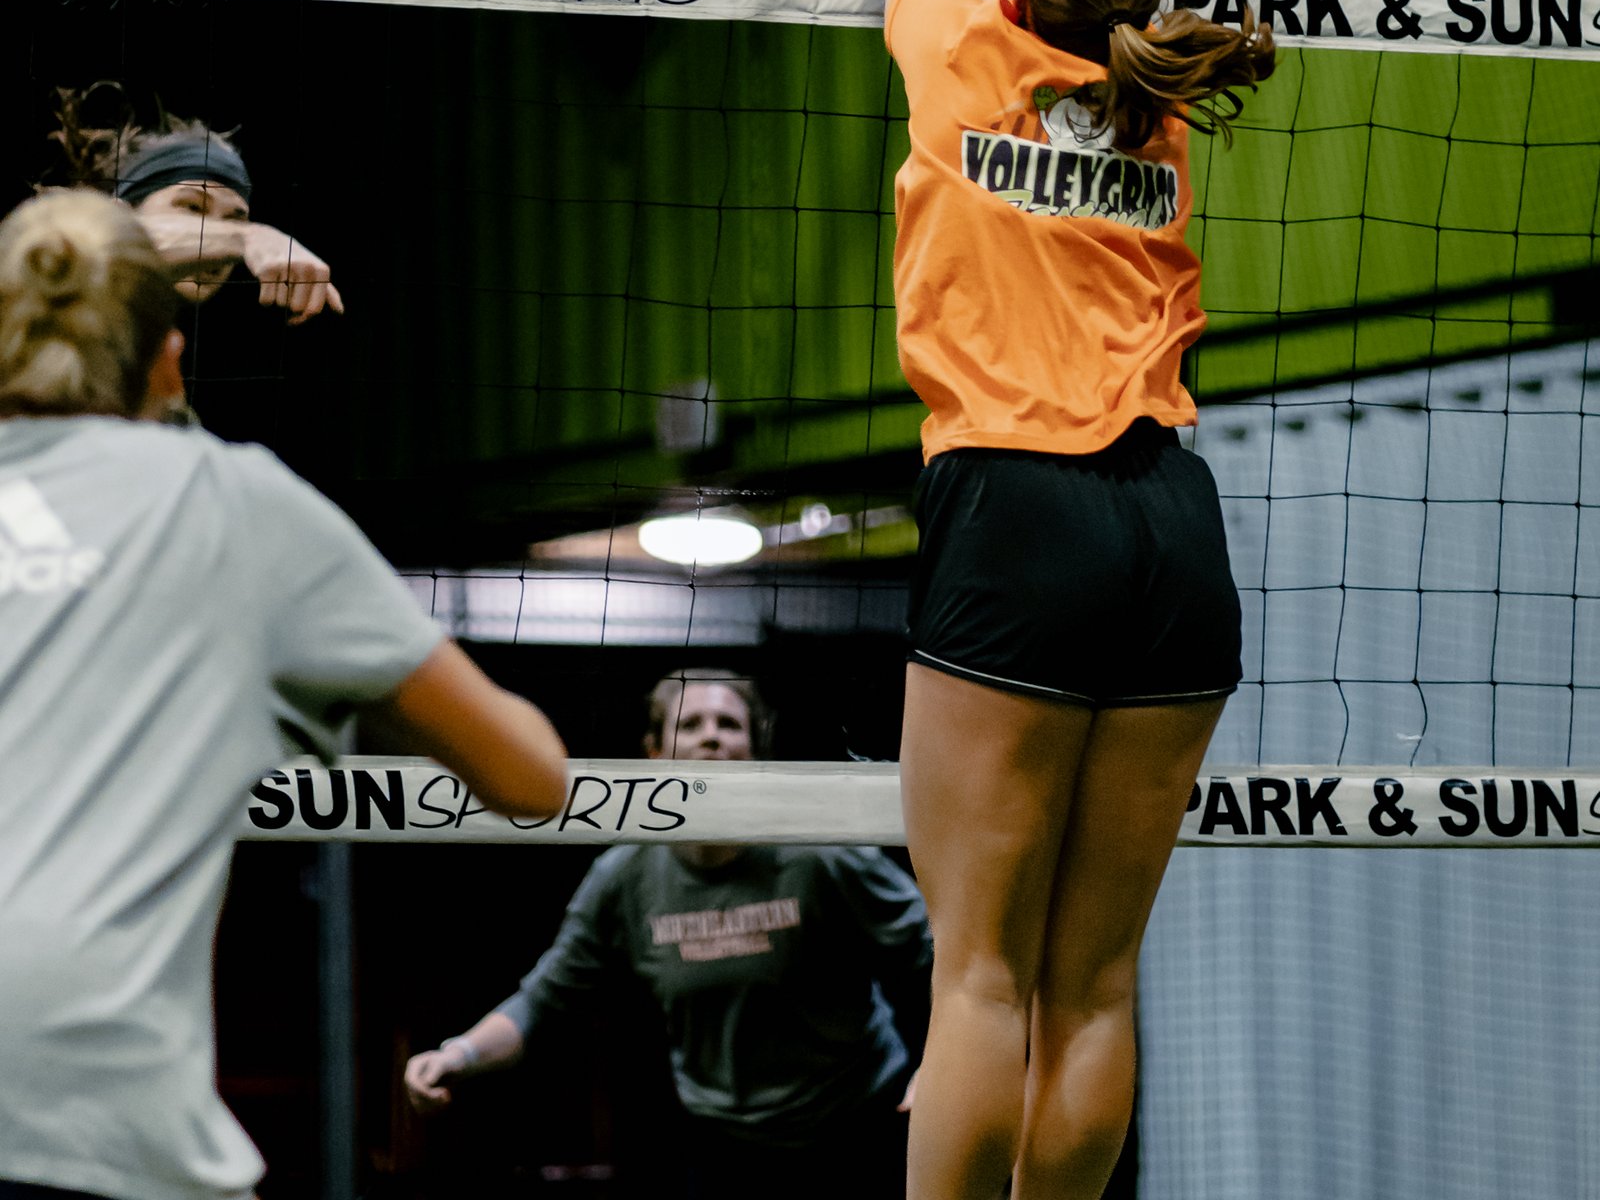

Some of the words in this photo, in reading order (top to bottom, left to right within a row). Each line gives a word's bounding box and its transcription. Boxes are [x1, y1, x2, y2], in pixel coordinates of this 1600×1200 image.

[248, 768, 405, 831] SUN
[1368, 777, 1419, 837] &
[1438, 777, 1579, 838] SUN
